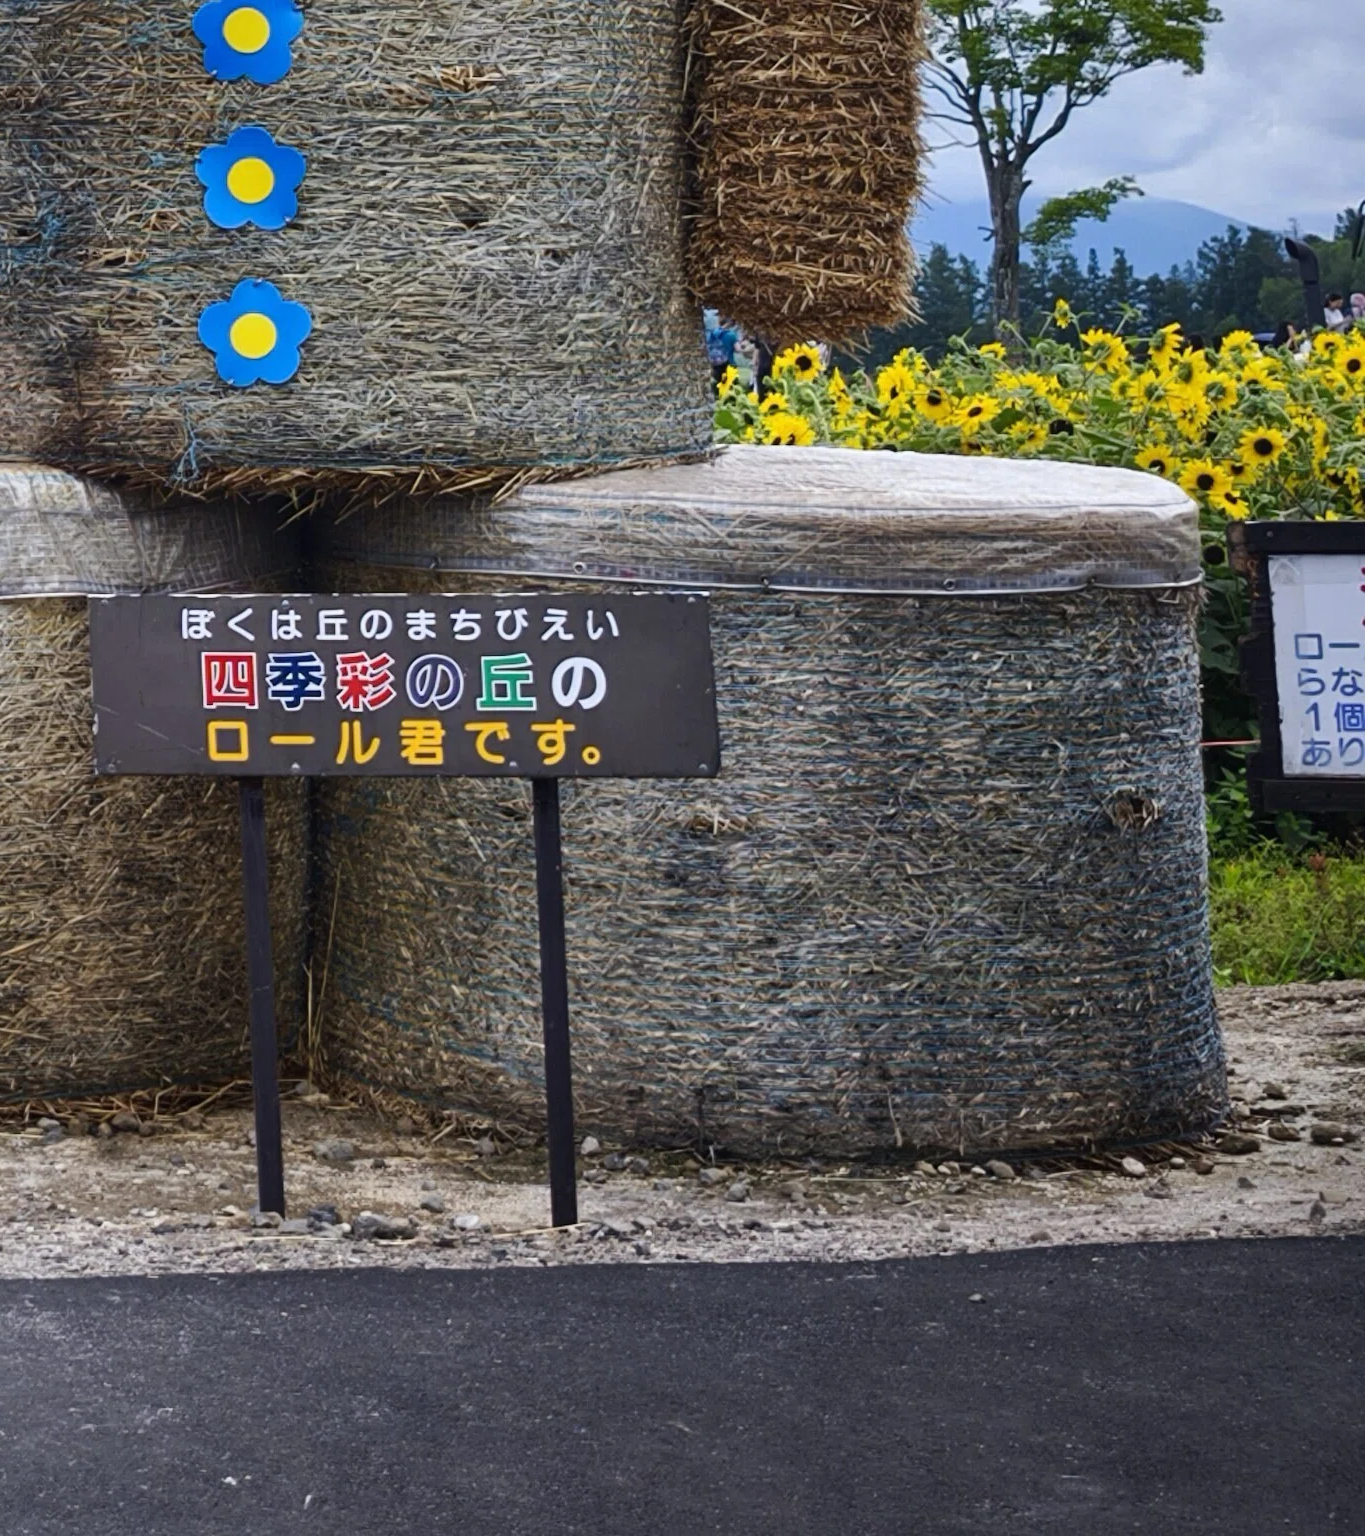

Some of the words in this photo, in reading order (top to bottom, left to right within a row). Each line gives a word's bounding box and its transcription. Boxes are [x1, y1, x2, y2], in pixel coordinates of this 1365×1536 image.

[181, 608, 621, 642] ぼくは丘のまちびえい
[200, 650, 608, 712] 四季彩の丘の
[206, 718, 601, 766] ロール君です。
